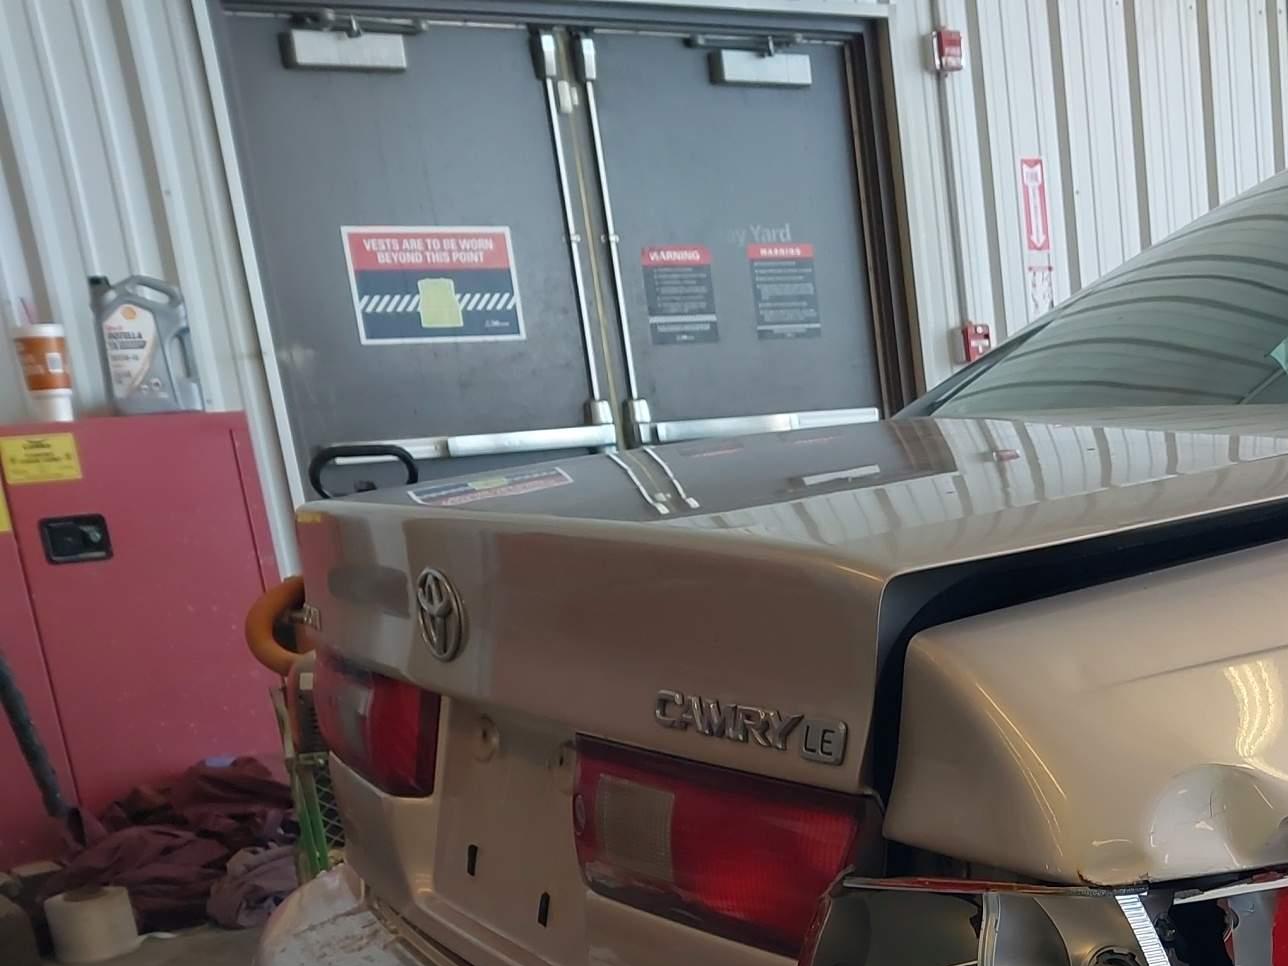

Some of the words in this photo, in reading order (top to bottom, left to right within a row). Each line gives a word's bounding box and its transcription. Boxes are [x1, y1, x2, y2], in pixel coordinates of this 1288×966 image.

[363, 237, 400, 251] VESTS
[402, 238, 425, 250] ARE
[427, 238, 441, 250] TO
[443, 238, 459, 250] BE
[460, 237, 494, 250] WORN
[377, 251, 423, 263] BEYOND
[425, 251, 450, 263] THIS
[452, 251, 486, 263] POINT
[649, 249, 701, 262] WARNING
[655, 689, 805, 751] CAMRY
[802, 722, 839, 759] LE
